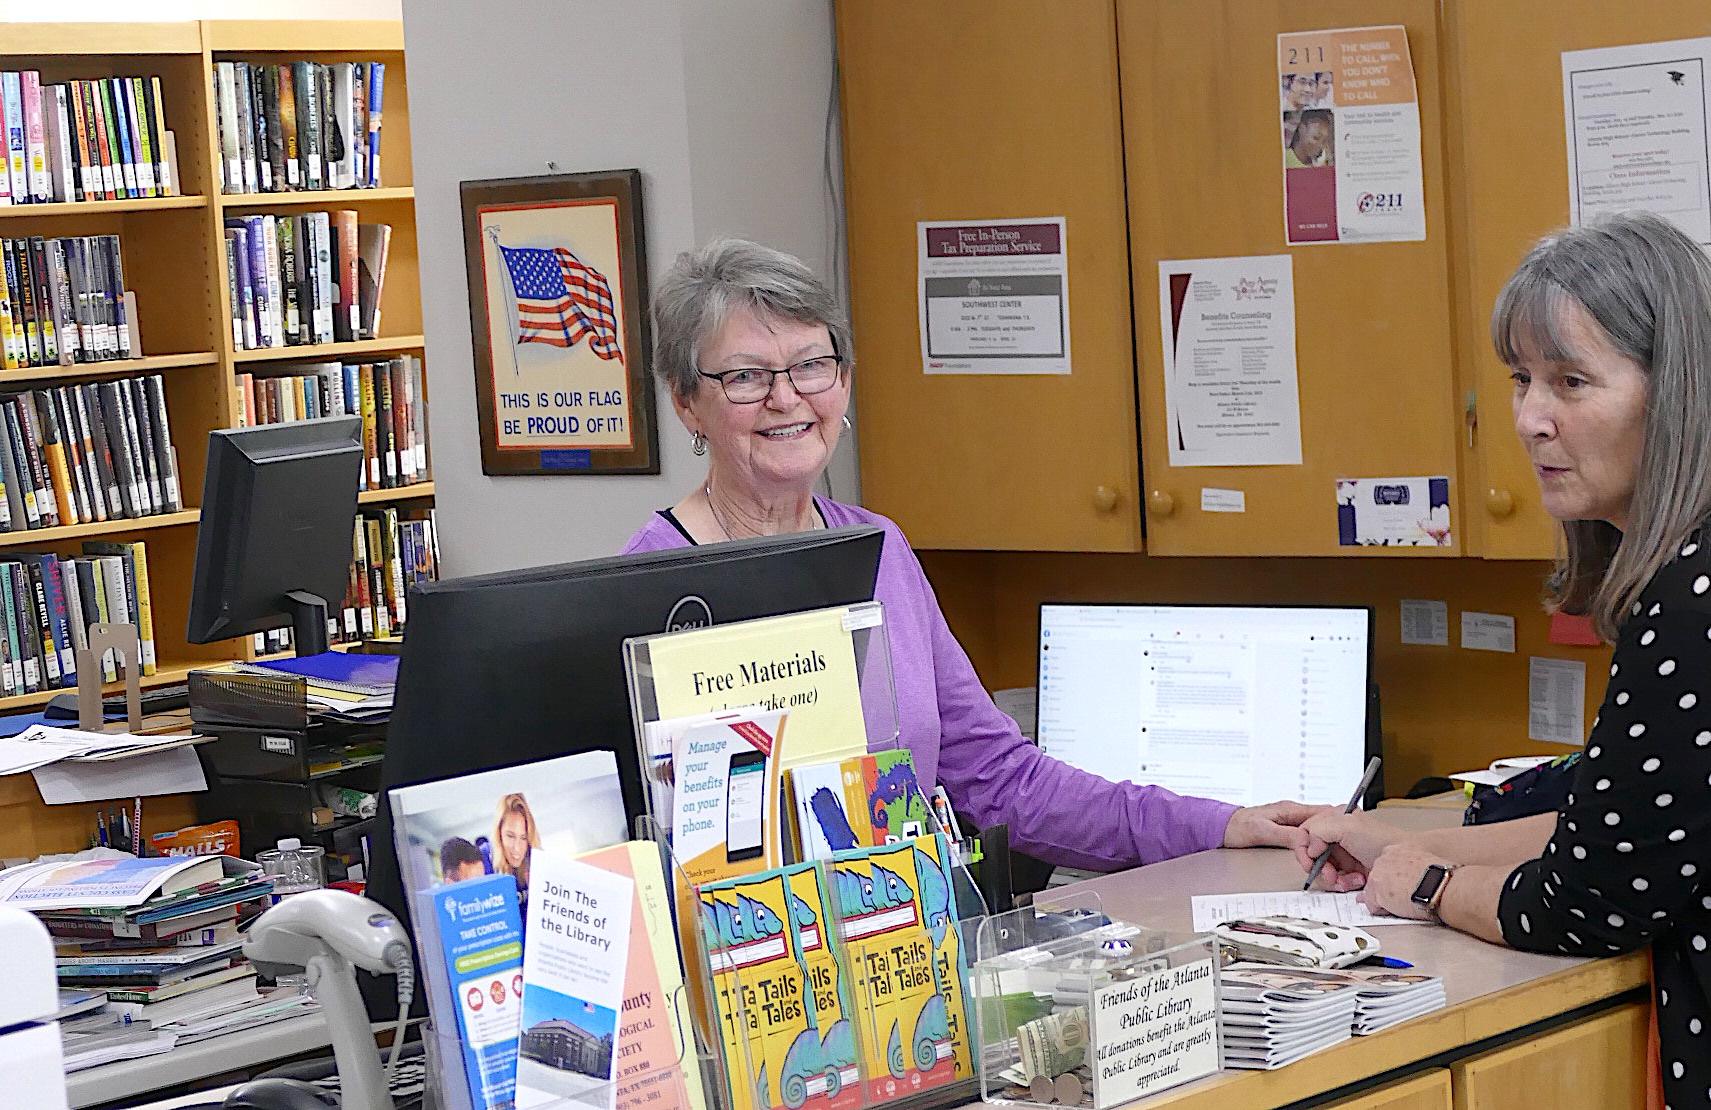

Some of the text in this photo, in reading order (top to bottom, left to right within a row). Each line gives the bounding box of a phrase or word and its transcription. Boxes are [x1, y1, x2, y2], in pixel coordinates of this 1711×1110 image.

[1289, 47, 1324, 64] 211
[958, 228, 1020, 242] Free In-Person
[941, 240, 1042, 256] Tax Preparation Service
[284, 255, 295, 283] ROBERTS
[24, 287, 32, 304] END
[333, 372, 341, 405] ROLLINS
[500, 390, 622, 409] THIS IS OUR FLAG
[504, 416, 624, 435] BE PROUD OF IT!
[22, 409, 35, 450] CONSPIRACY
[33, 461, 42, 483] BONES
[35, 582, 49, 628] CLARE REVELL
[47, 559, 69, 638] SHIVER ALLIE
[692, 650, 826, 696] Free Materials
[790, 686, 818, 706] one)
[687, 739, 727, 755] Manage
[684, 762, 708, 776] your
[683, 776, 723, 793] benefits
[682, 797, 720, 815] on your
[682, 817, 715, 836] phone.
[169, 838, 226, 858] HALLS
[543, 881, 598, 909] Join The
[542, 899, 607, 930] Friends of
[477, 920, 508, 937] CONTROL
[541, 917, 611, 952] the Library
[867, 951, 889, 975] Tai
[891, 942, 927, 965] Tails
[758, 975, 798, 999] Tails
[870, 975, 892, 998] Tal
[895, 964, 930, 991] Tales
[1100, 965, 1209, 1010] Friends of the Atlanta
[762, 1000, 801, 1026] Tales
[815, 990, 835, 1013] les
[1120, 997, 1193, 1030] Public Library
[620, 1018, 655, 1038] OGICAL
[1108, 1035, 1145, 1057] donations
[1147, 1022, 1173, 1043] benefit
[1174, 1018, 1185, 1033] the
[1186, 1009, 1216, 1030] Atlanta
[1103, 1027, 1212, 1080] Public Library and are greatly
[624, 1065, 638, 1076] BOX
[1136, 1058, 1181, 1089] appreciated.
